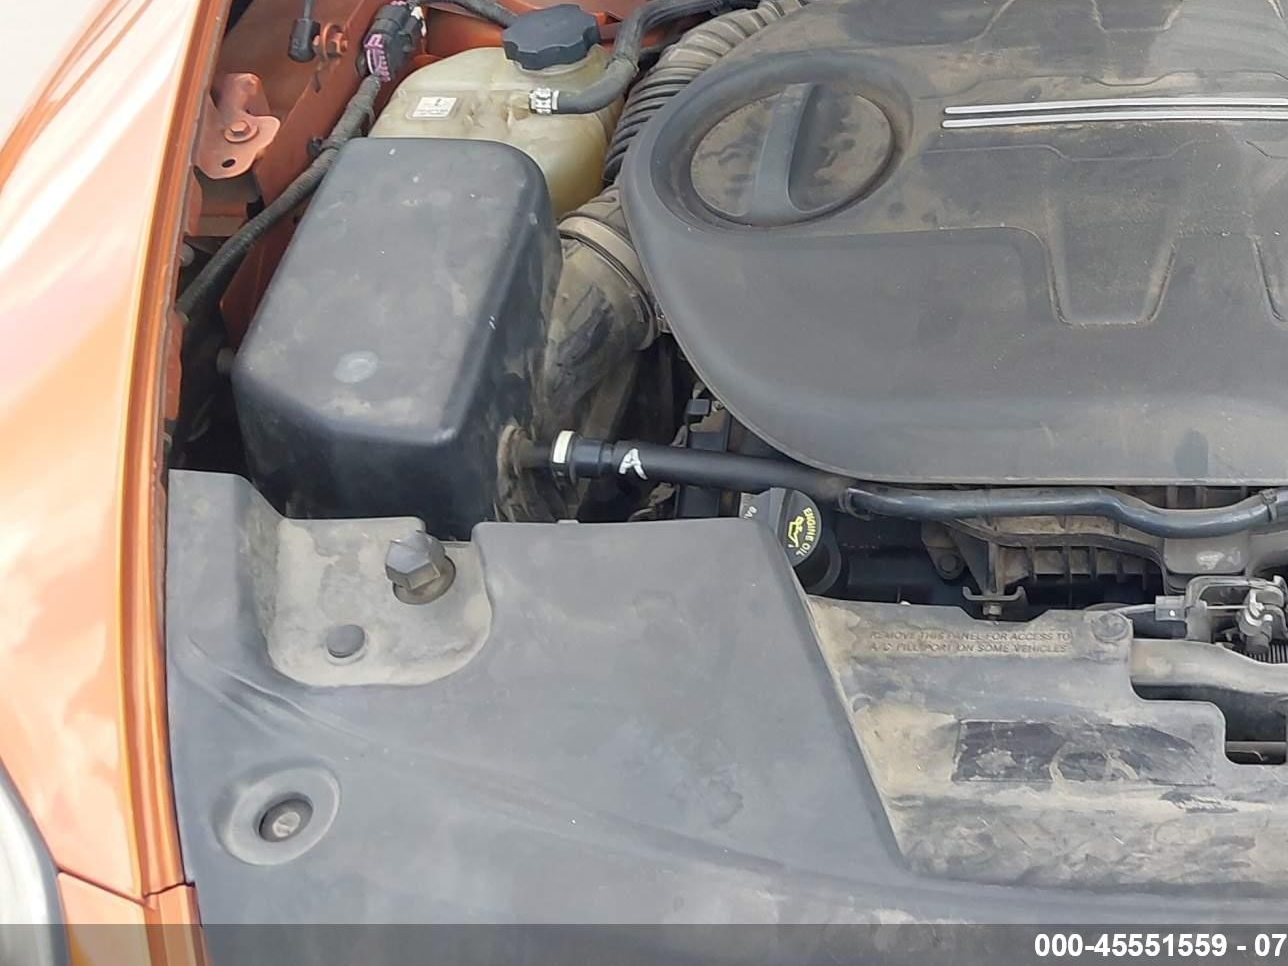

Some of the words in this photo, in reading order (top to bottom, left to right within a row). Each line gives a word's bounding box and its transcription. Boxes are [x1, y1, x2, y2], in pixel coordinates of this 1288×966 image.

[619, 448, 649, 480] A
[802, 507, 817, 542] ENGINE
[796, 542, 811, 556] OIL
[986, 632, 1008, 641] FOR
[1010, 632, 1054, 641] ACCESS
[1056, 632, 1071, 641] TO
[957, 643, 975, 652] ON
[977, 643, 1010, 652] SOME
[1013, 643, 1067, 652] VEHICLES
